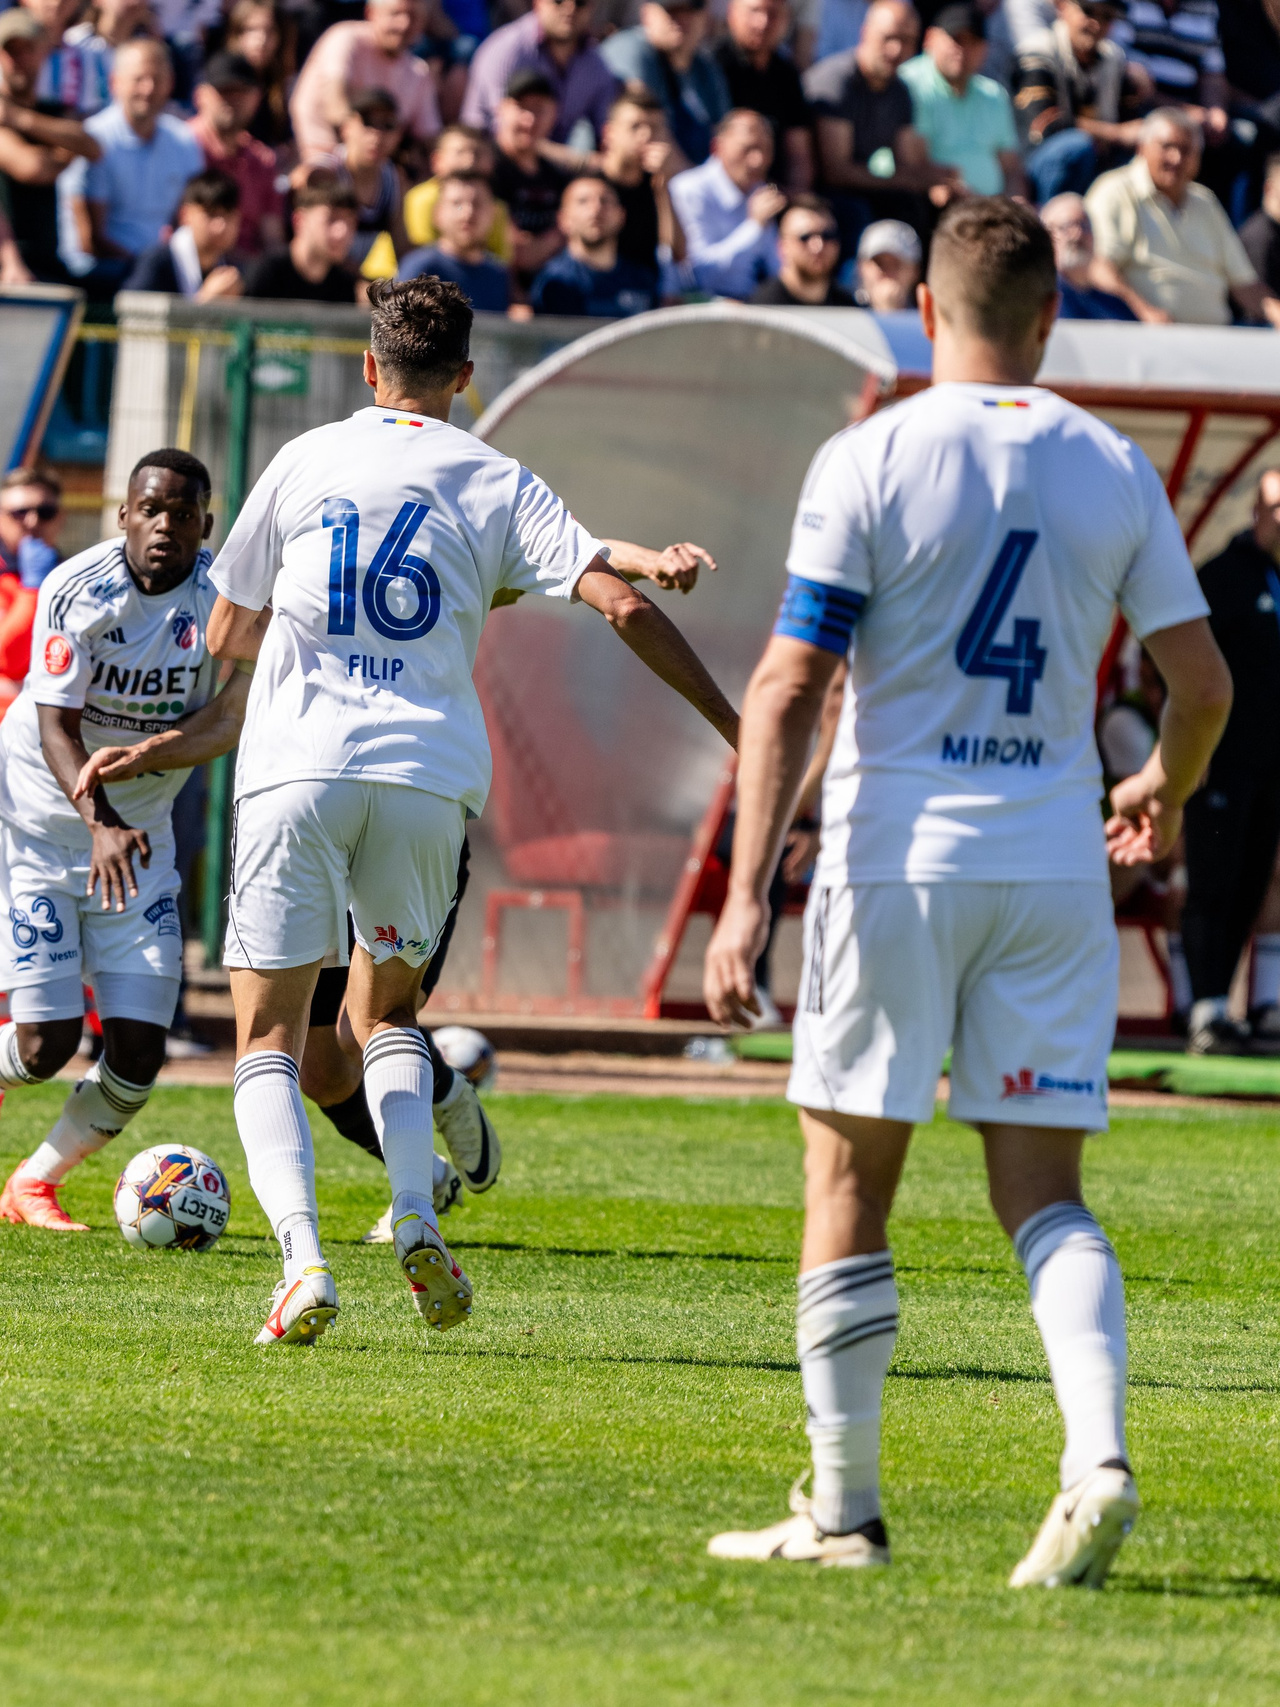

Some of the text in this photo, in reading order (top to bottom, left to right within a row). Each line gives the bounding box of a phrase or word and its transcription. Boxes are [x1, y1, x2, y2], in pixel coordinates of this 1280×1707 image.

[322, 498, 441, 641] 16
[955, 529, 1048, 716] 4
[90, 655, 204, 696] UNIBET
[349, 654, 404, 681] FILIP
[942, 732, 1044, 769] MIRON
[9, 896, 63, 949] 83
[178, 1196, 227, 1227] SELECT
[283, 1230, 293, 1261] SOCKS
